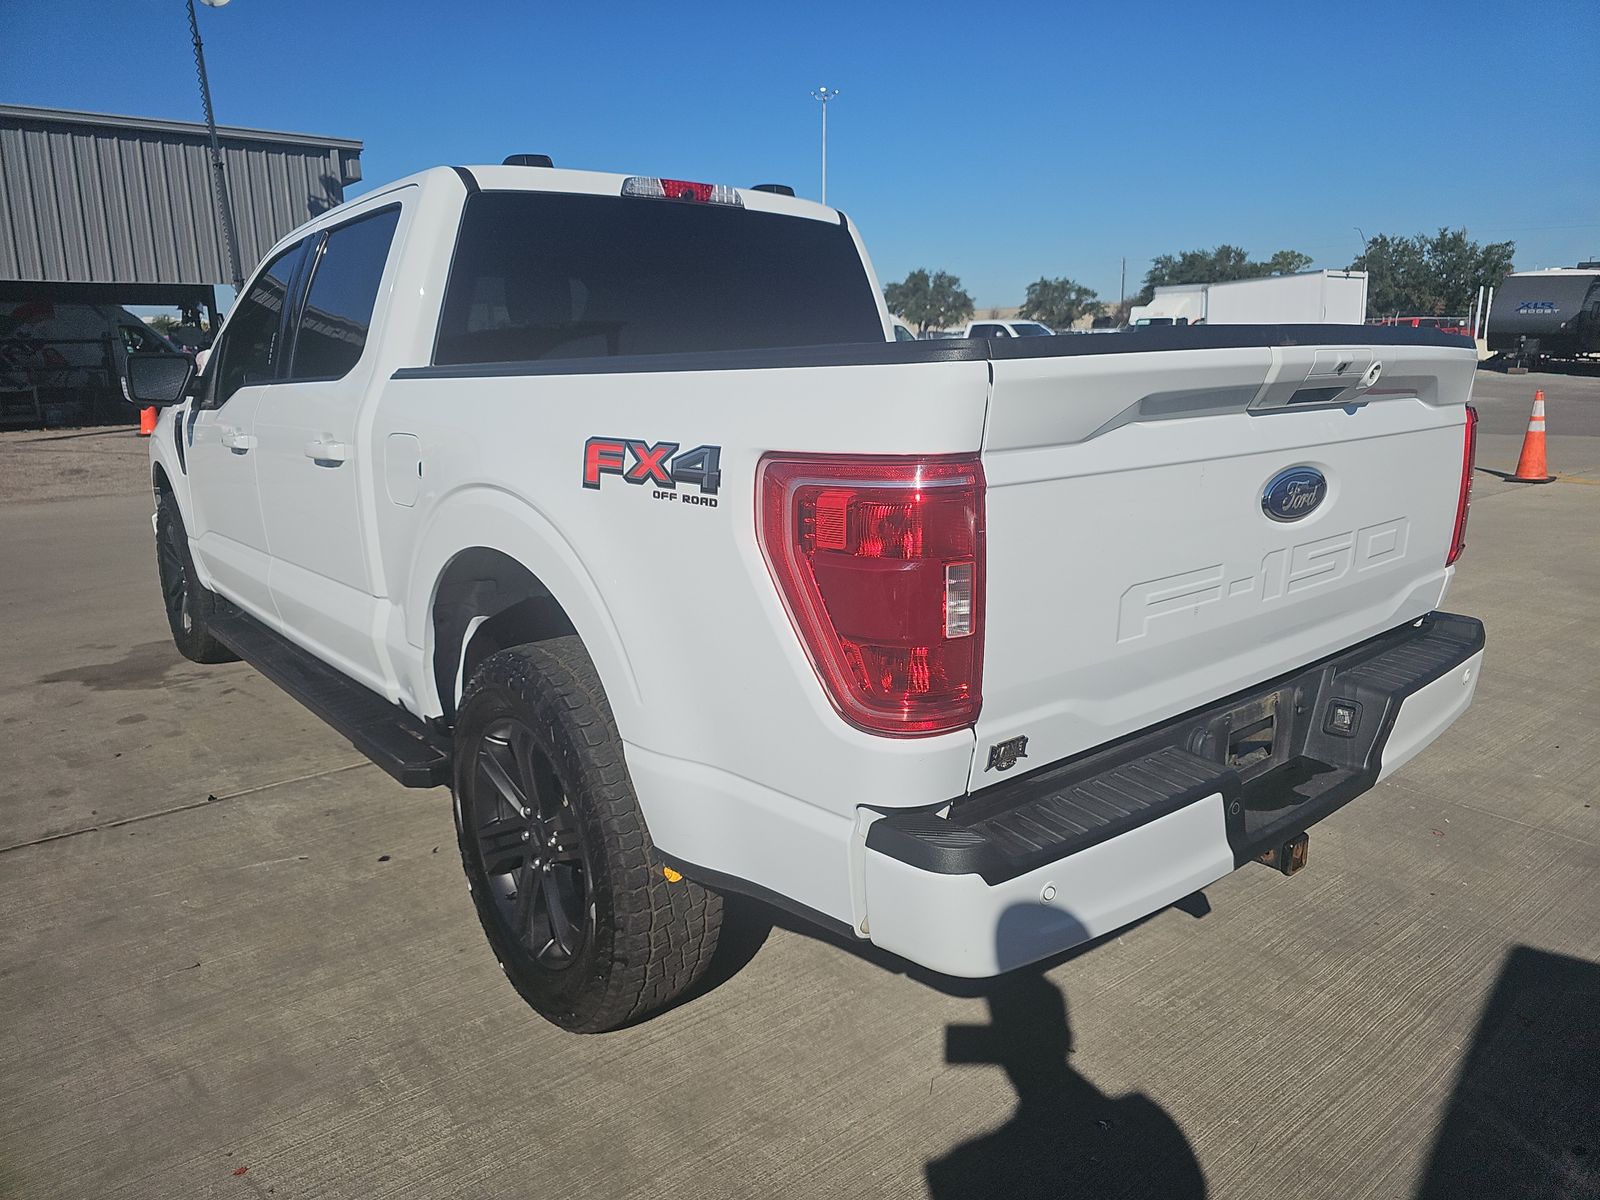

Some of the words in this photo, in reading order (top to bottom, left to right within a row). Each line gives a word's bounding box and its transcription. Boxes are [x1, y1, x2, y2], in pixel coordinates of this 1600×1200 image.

[582, 436, 721, 495] FX4
[652, 490, 677, 501] OFF
[682, 494, 718, 507] ROAD
[1282, 480, 1319, 511] Ford
[1117, 516, 1410, 643] F-150
